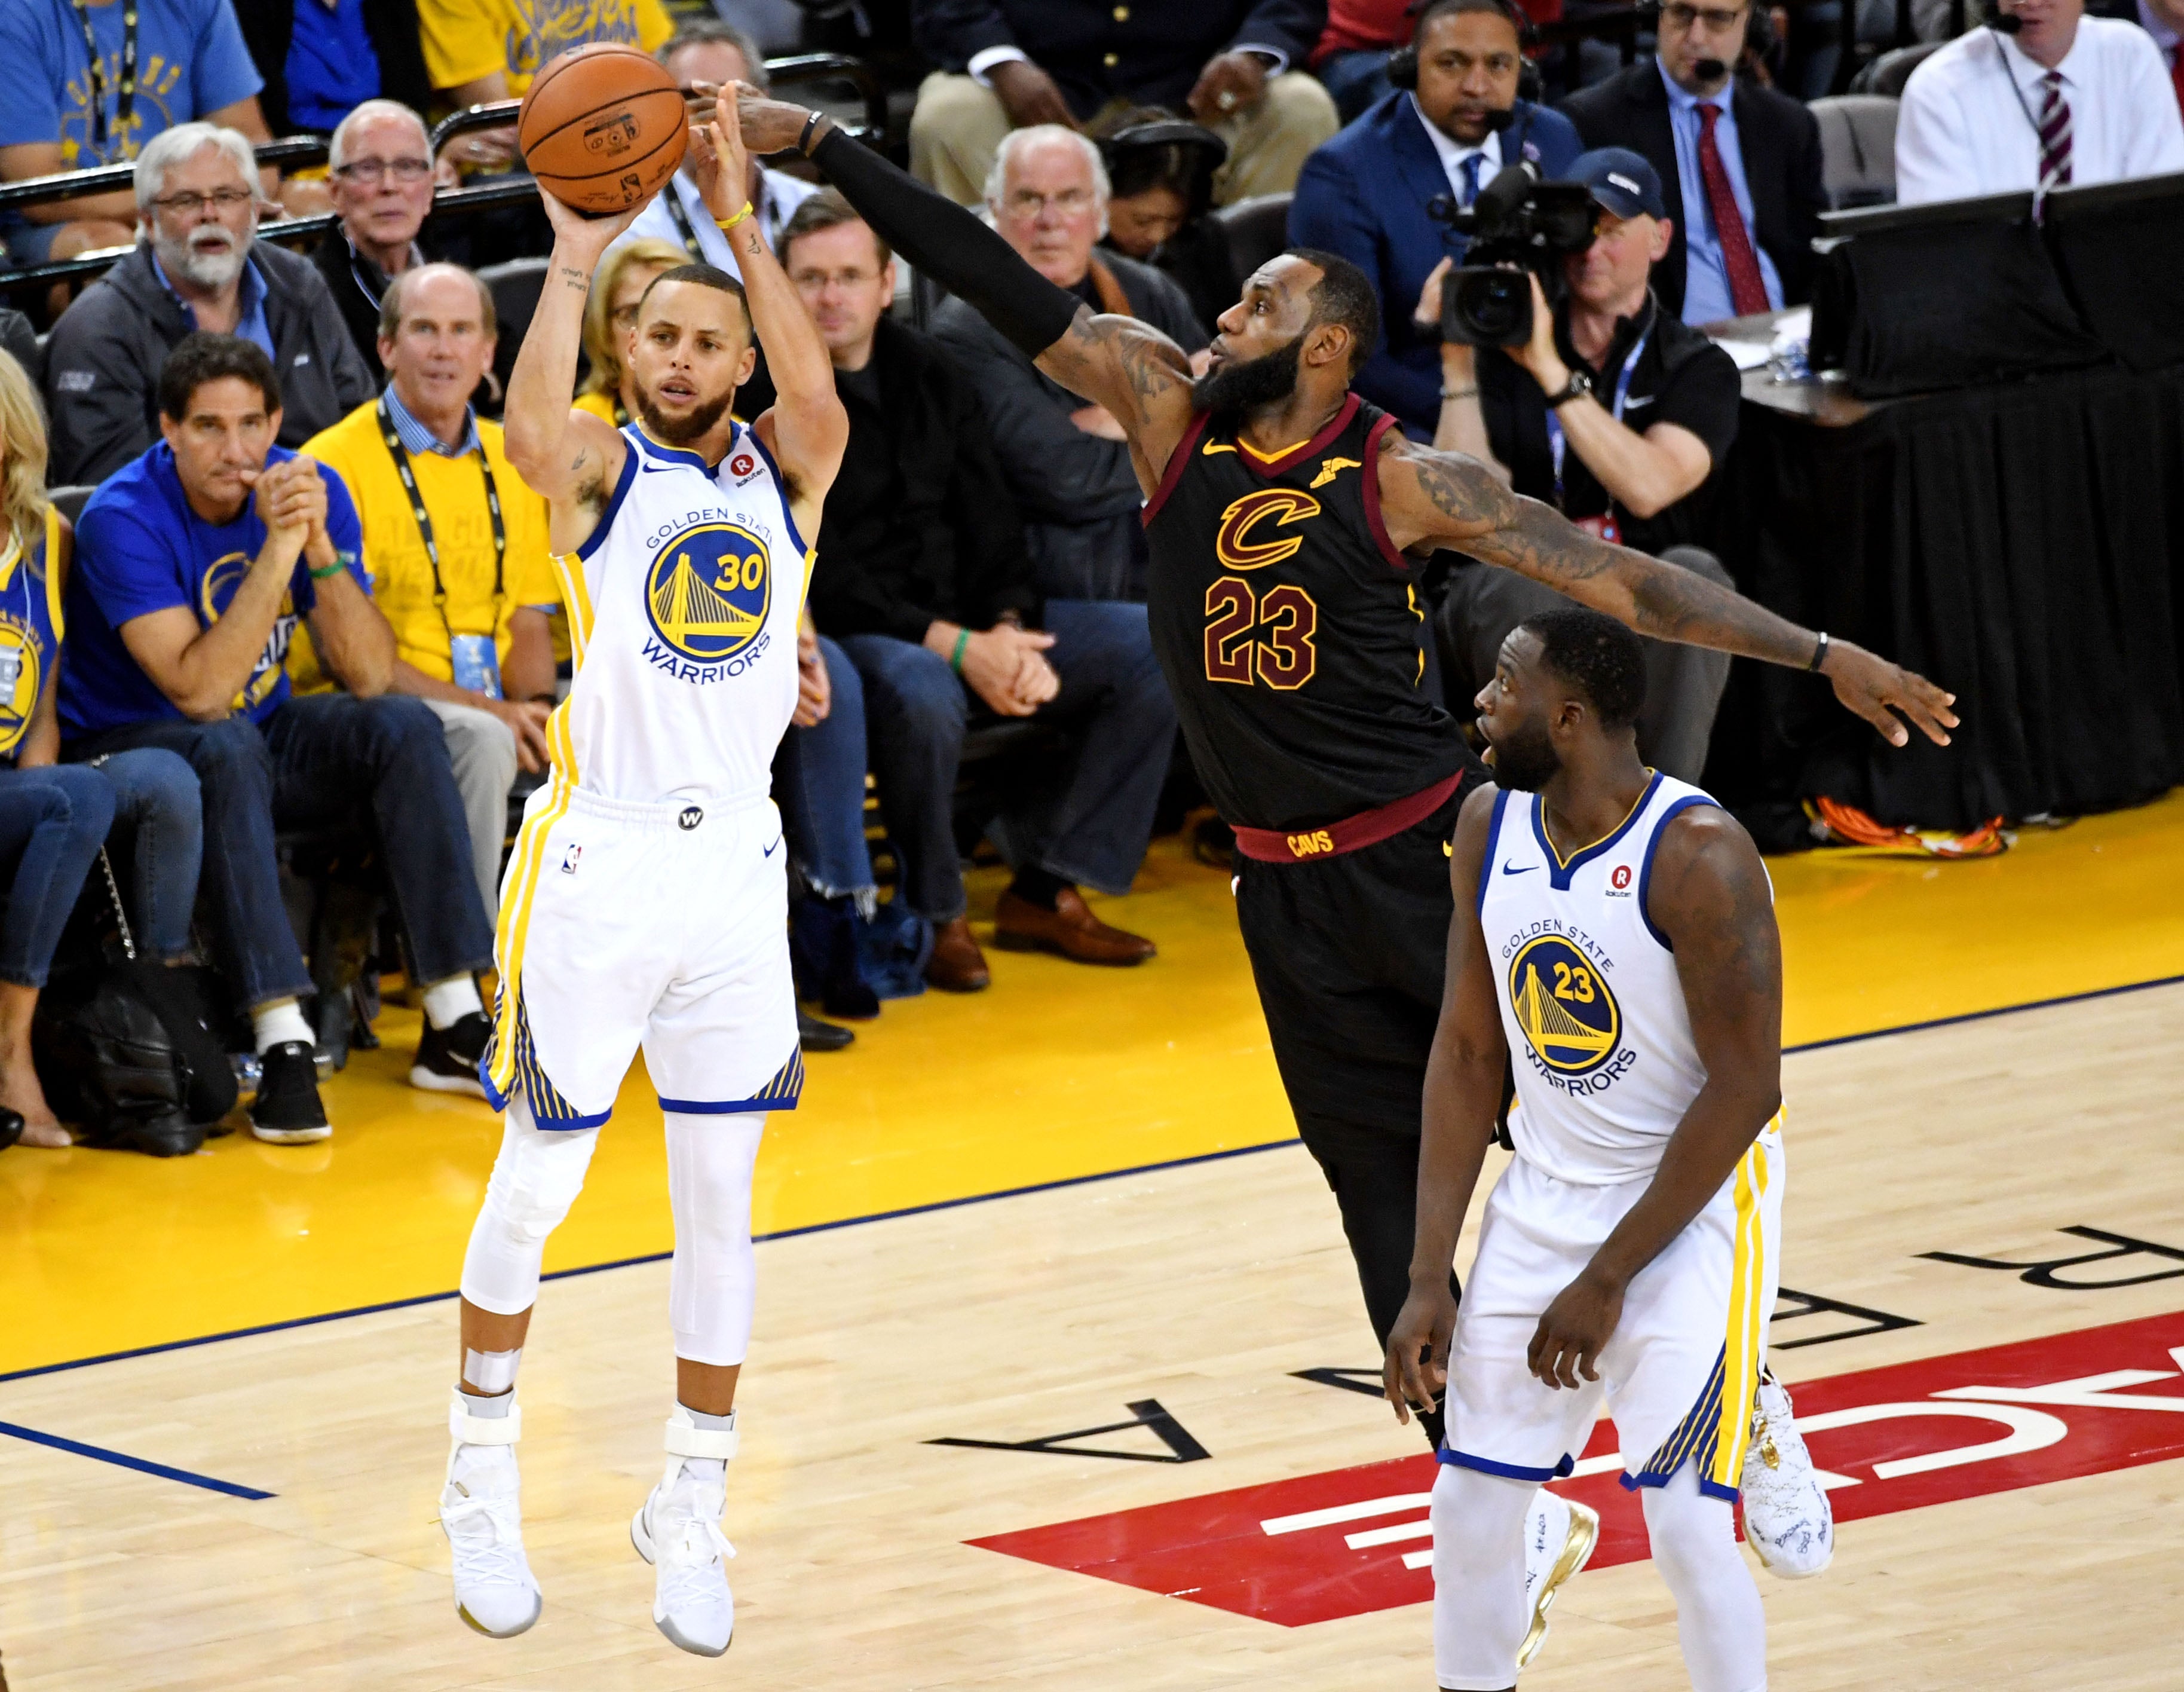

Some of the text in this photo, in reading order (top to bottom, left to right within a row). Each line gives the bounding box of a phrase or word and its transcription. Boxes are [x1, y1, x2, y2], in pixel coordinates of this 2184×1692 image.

[735, 458, 751, 473] R
[736, 467, 766, 488] Rakuten
[646, 507, 728, 549] GOLDEN
[1216, 488, 1321, 570] C
[714, 553, 764, 592] 30
[1204, 576, 1317, 690] 23
[641, 631, 771, 686] WARRIORS
[1286, 830, 1334, 858] CAVS
[1502, 918, 1615, 972] GOLDEN STATE
[1553, 961, 1595, 1003] 23
[1525, 1043, 1637, 1097] WARRIORS
